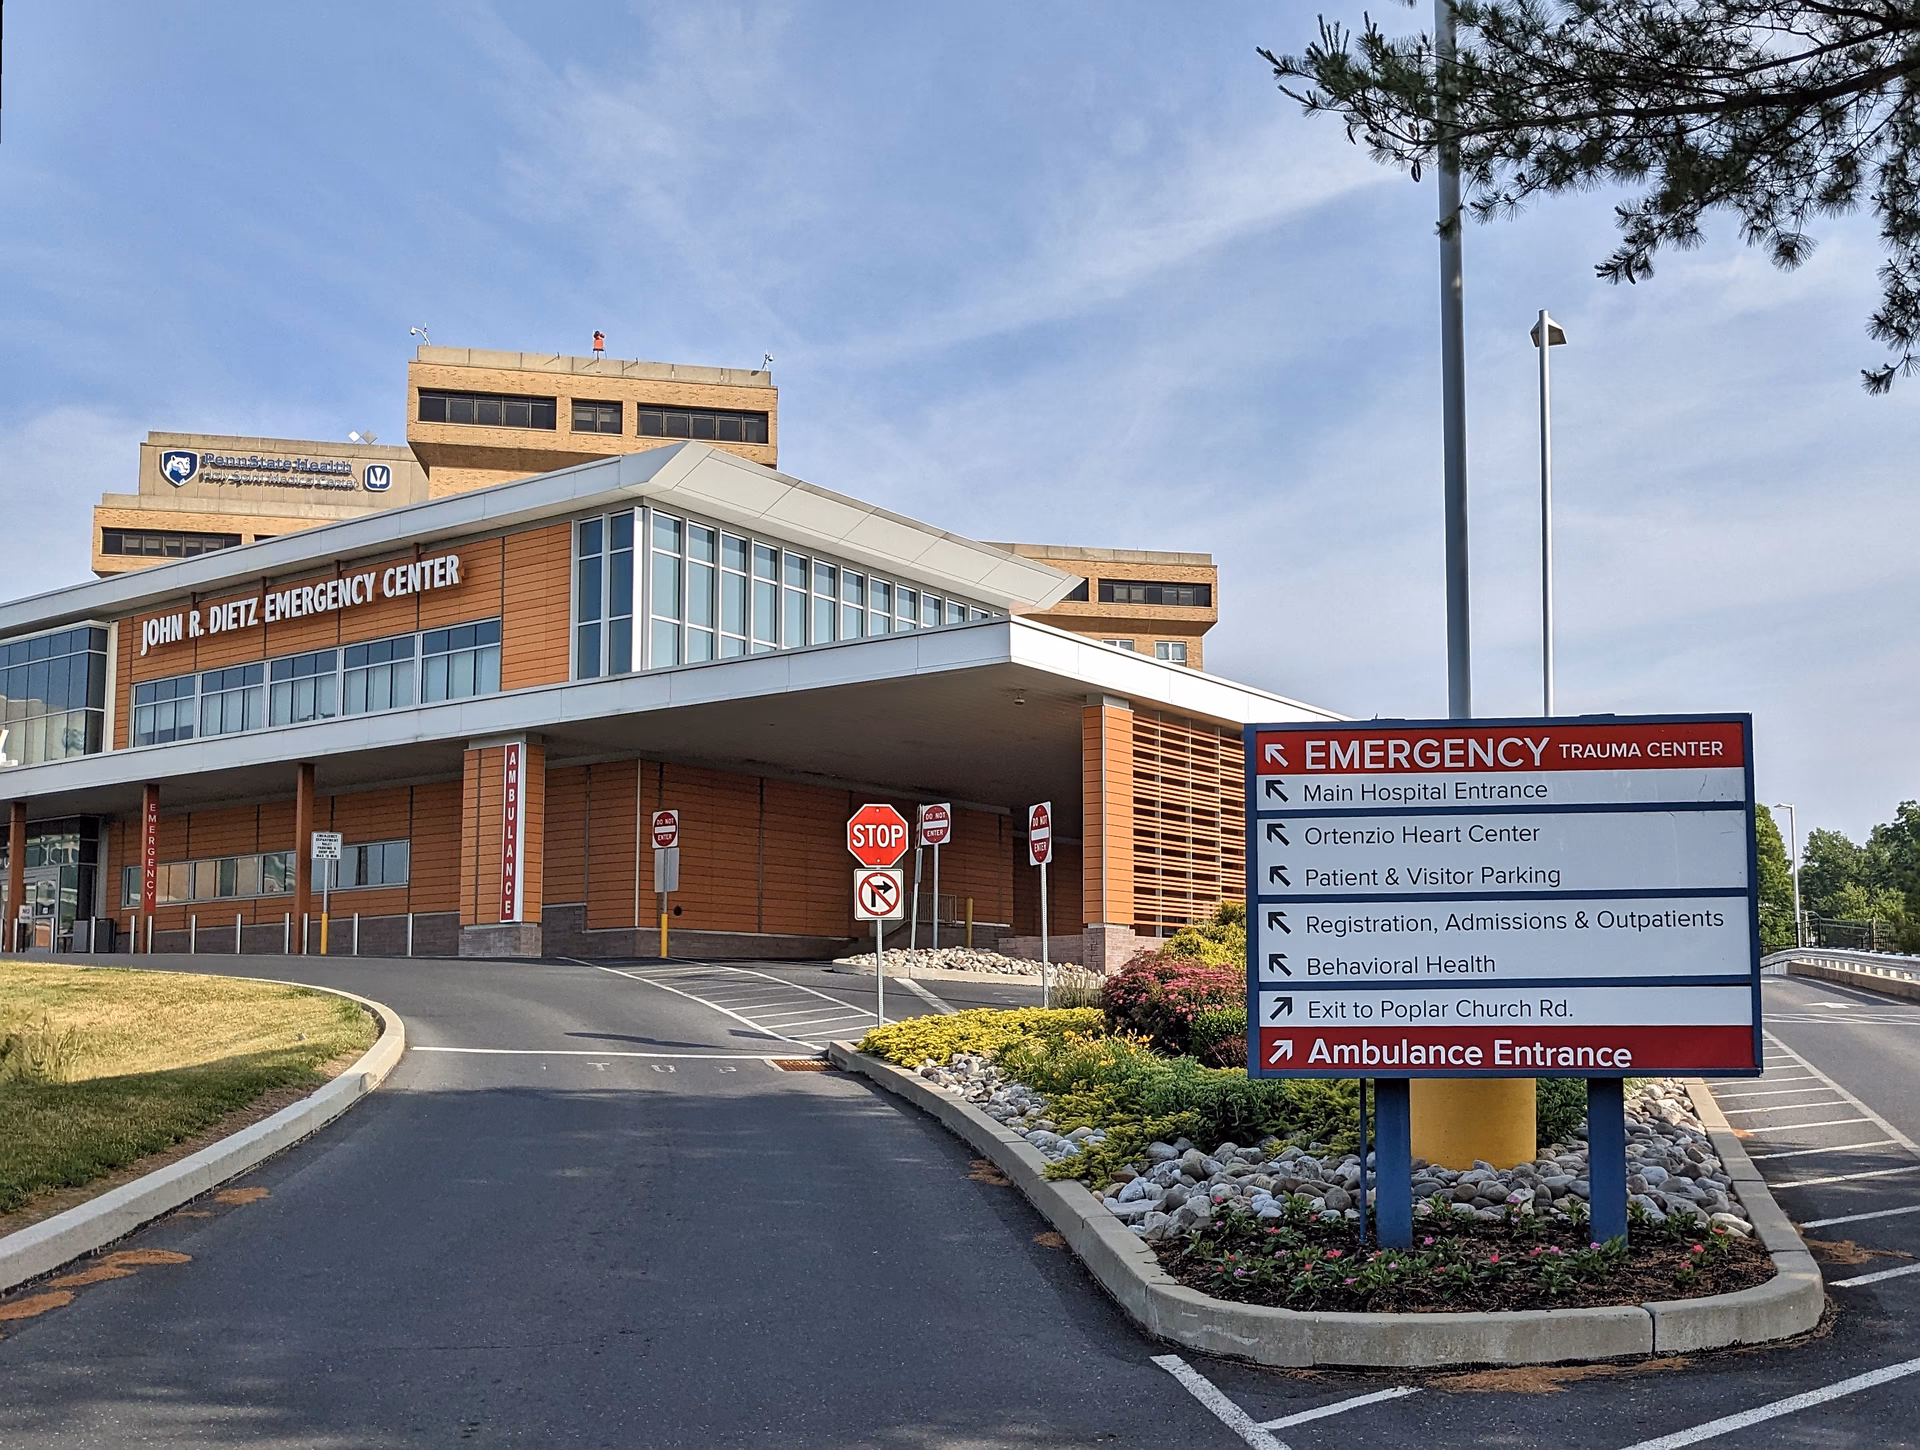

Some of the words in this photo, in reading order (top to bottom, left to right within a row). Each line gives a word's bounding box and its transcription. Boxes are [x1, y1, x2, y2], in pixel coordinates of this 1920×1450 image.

[296, 457, 353, 474] Health
[141, 612, 183, 656] JOHN
[188, 610, 205, 638] R.
[209, 597, 259, 634] DIETZ
[264, 571, 377, 623] EMERGENCY
[382, 554, 460, 599] CENTER
[1305, 737, 1551, 770] EMERGENCY
[1558, 742, 1642, 759] TRAUMA
[1646, 741, 1723, 757] CENTER
[1304, 784, 1353, 802] Main
[1361, 782, 1447, 805] Hospital
[1454, 781, 1548, 800] Entrance
[664, 817, 674, 825] NOT
[935, 811, 946, 819] NOT
[1032, 817, 1039, 827] DO
[1039, 814, 1048, 825] NOT
[504, 751, 517, 914] AMBULANCE
[852, 823, 904, 848] STOP
[926, 829, 944, 837] ENTER
[1304, 826, 1395, 845] Ortenzio
[1402, 825, 1462, 844] Heart
[1468, 824, 1541, 843] Center
[146, 803, 157, 900] EMERGENCY
[1034, 841, 1047, 852] ENTER
[1305, 868, 1379, 887] Patient
[1385, 867, 1400, 886] &
[1406, 867, 1474, 885] Visitor
[1481, 866, 1561, 888] Parking
[1306, 914, 1438, 938] Registration,
[1444, 912, 1567, 931] Admissions
[1574, 910, 1590, 929] &
[1597, 909, 1724, 933] Outpatients
[1307, 956, 1418, 976] Behavioral
[1426, 954, 1496, 974] Health
[1308, 1000, 1347, 1019] Exit
[1352, 1001, 1373, 1019] to
[1381, 999, 1449, 1023] Poplar
[1455, 999, 1532, 1018] Church
[1540, 999, 1573, 1018] Rd.
[1307, 1038, 1484, 1066] Ambulance
[1494, 1039, 1633, 1068] Entrance
